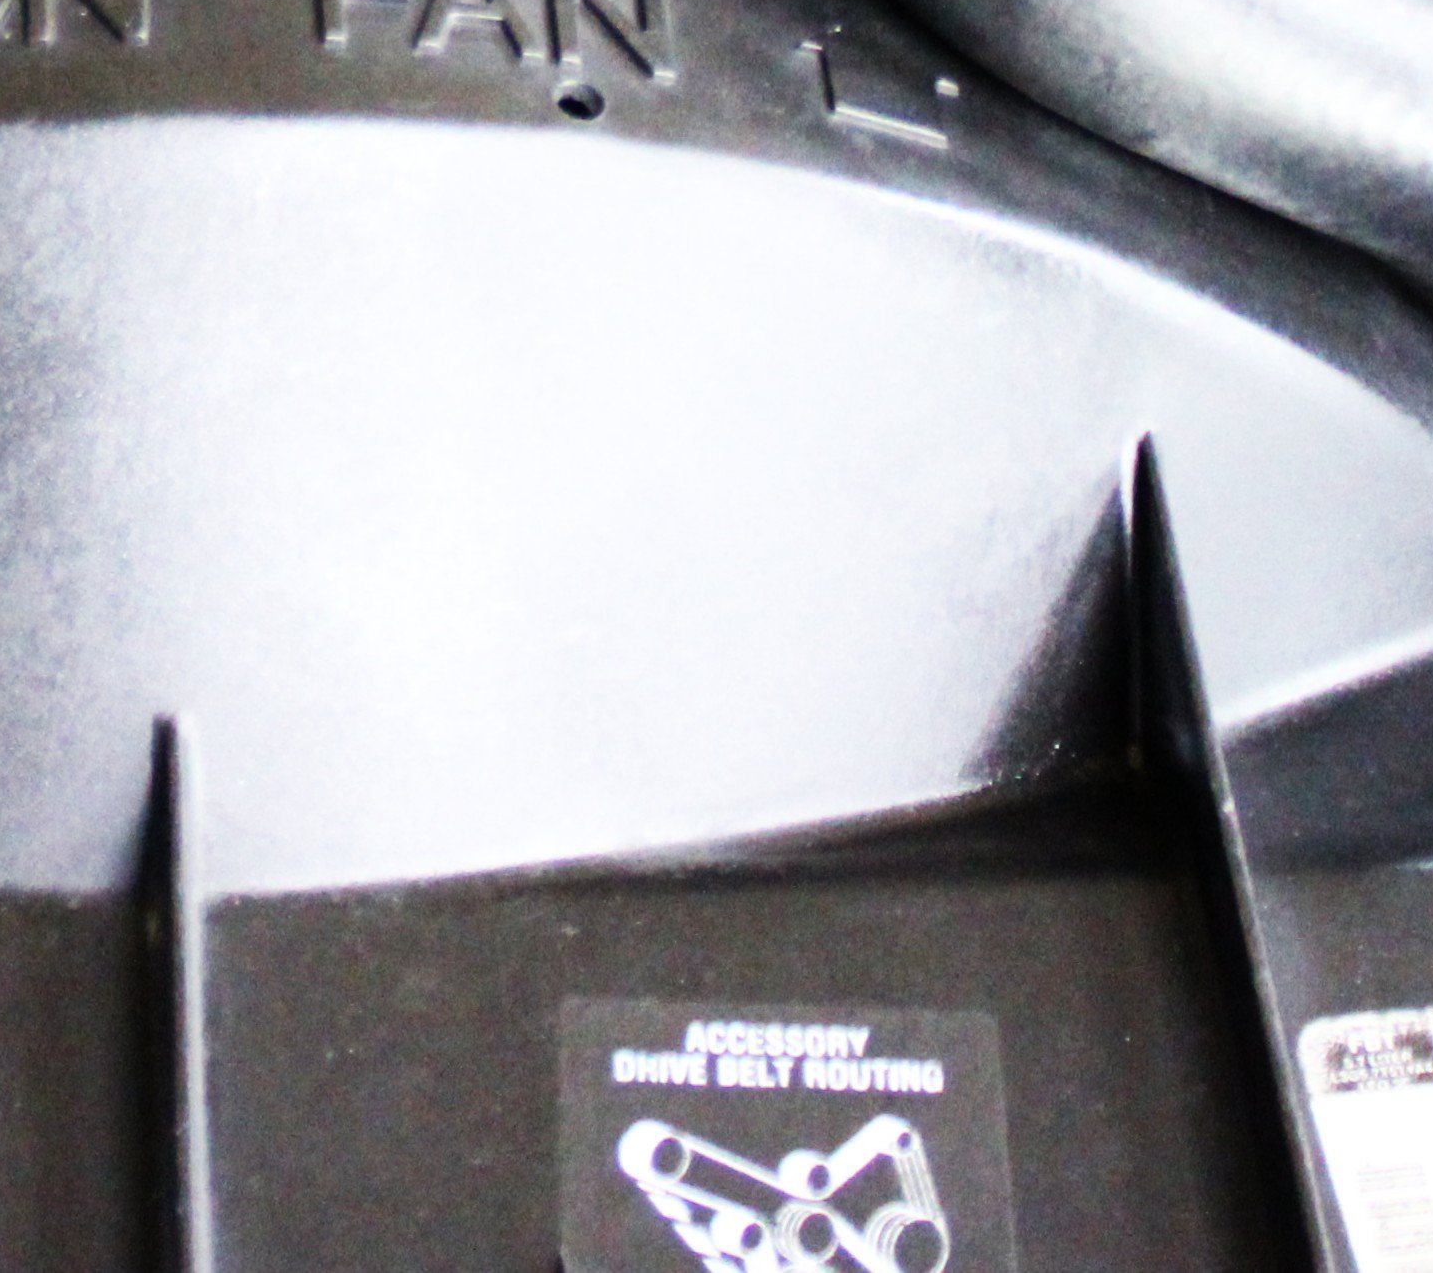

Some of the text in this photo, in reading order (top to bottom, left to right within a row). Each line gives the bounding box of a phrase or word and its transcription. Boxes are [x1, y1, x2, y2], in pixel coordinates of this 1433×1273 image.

[684, 1019, 871, 1058] ACCESSORY
[612, 1049, 945, 1094] DRIVE BELT ROUTING
